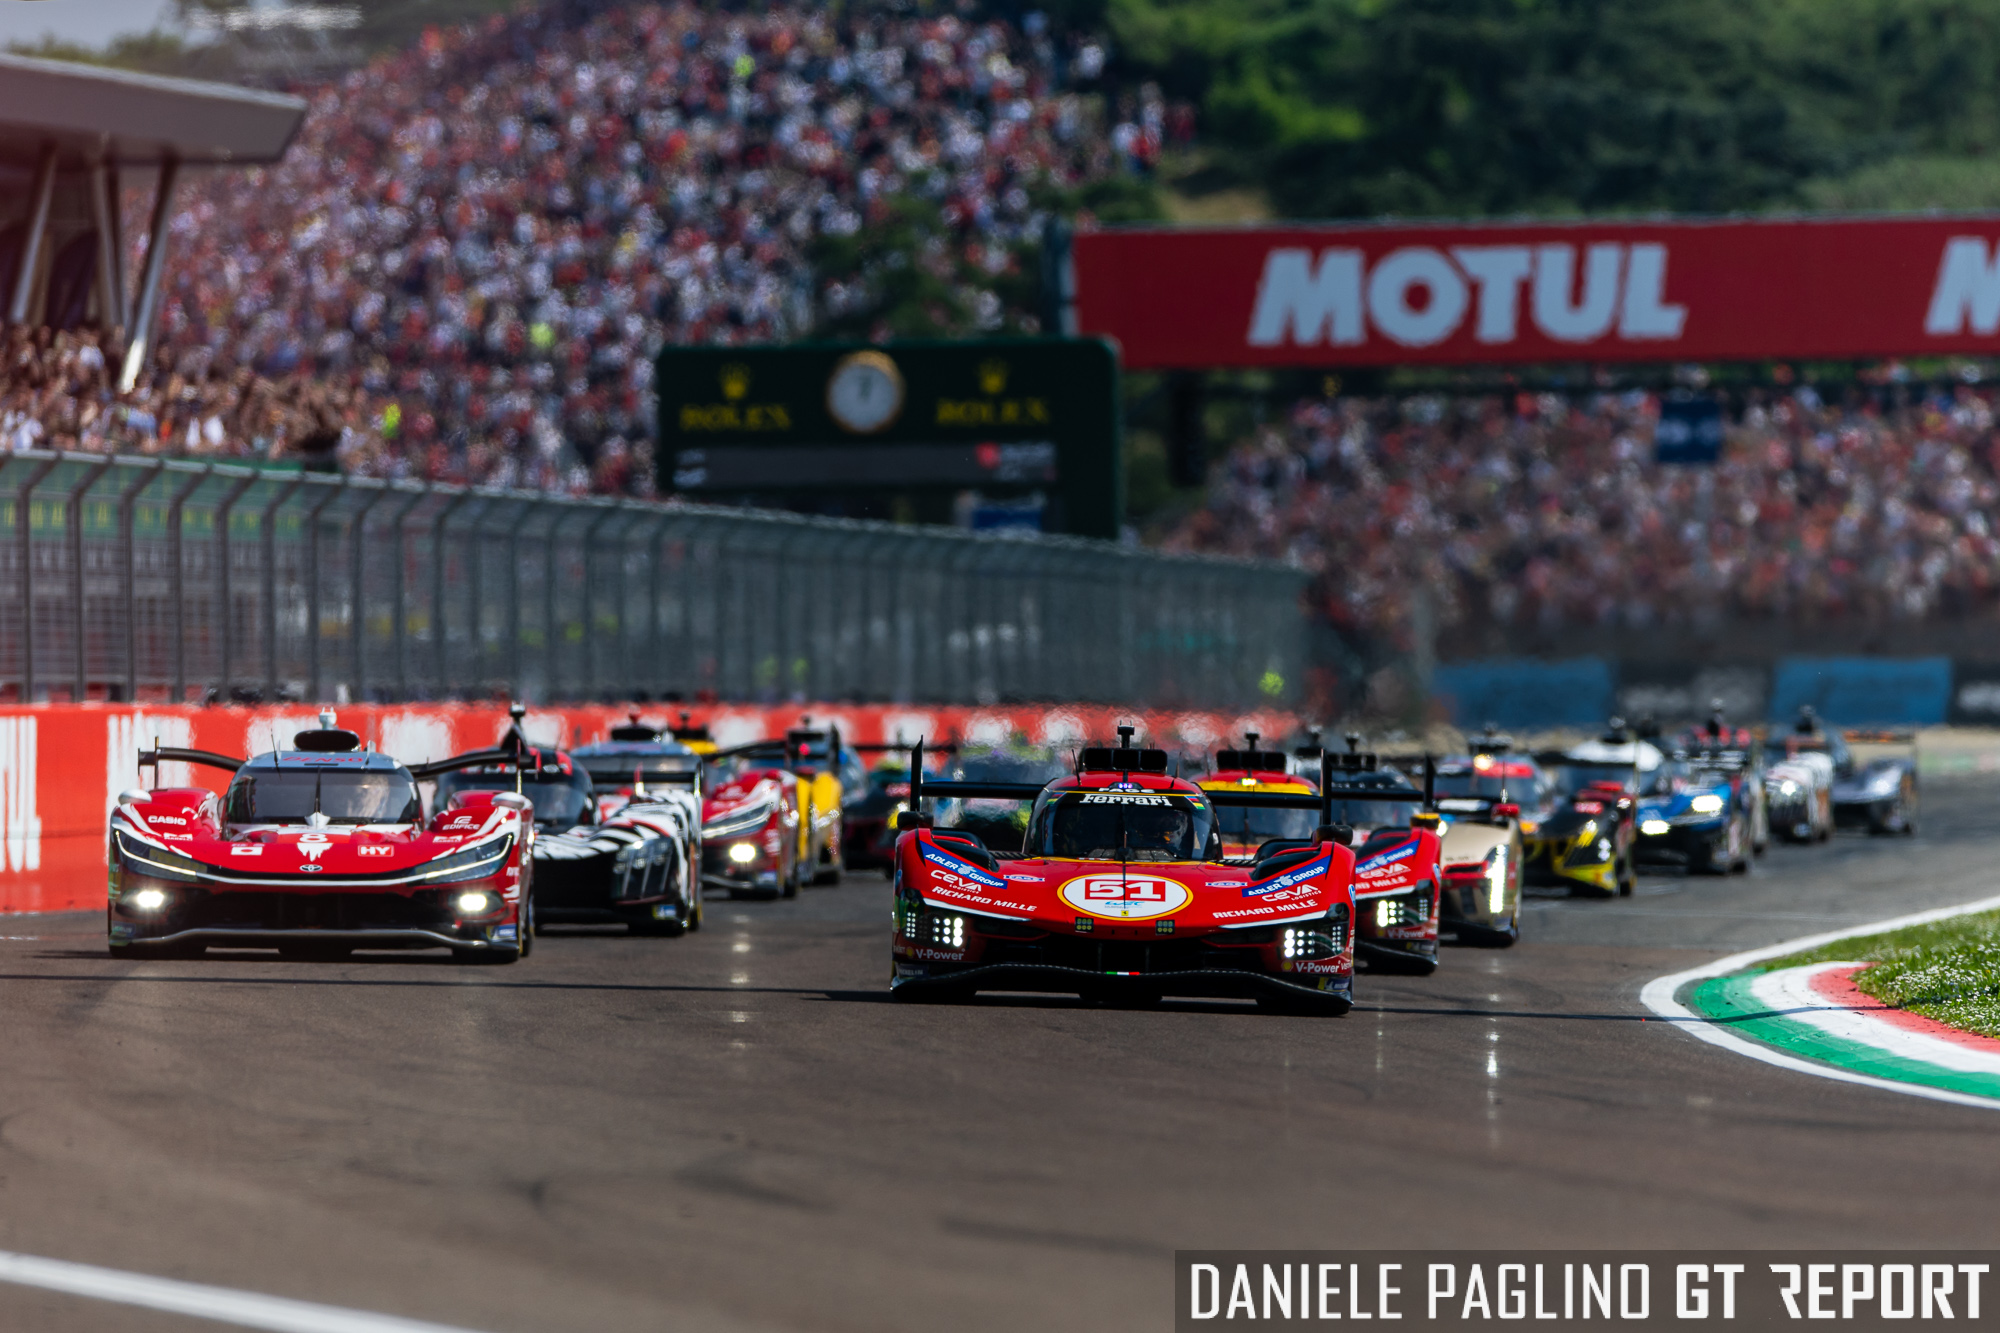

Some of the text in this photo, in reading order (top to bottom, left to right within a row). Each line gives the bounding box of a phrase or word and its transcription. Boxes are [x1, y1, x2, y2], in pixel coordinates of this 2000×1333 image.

[1247, 244, 1687, 346] MOTUL
[1080, 794, 1173, 806] Ferrari
[147, 815, 187, 826] CASIO
[442, 823, 481, 831] EDIFICE
[299, 833, 328, 843] 8
[360, 846, 391, 856] HY
[925, 853, 1004, 887] ADLER GROUP
[1247, 866, 1325, 896] ADLER GROUP
[1089, 881, 1161, 900] 51
[931, 886, 1037, 912] RICHARD MILLE
[1212, 899, 1319, 919] RICHARD MILLE
[1295, 961, 1341, 973] V-Power
